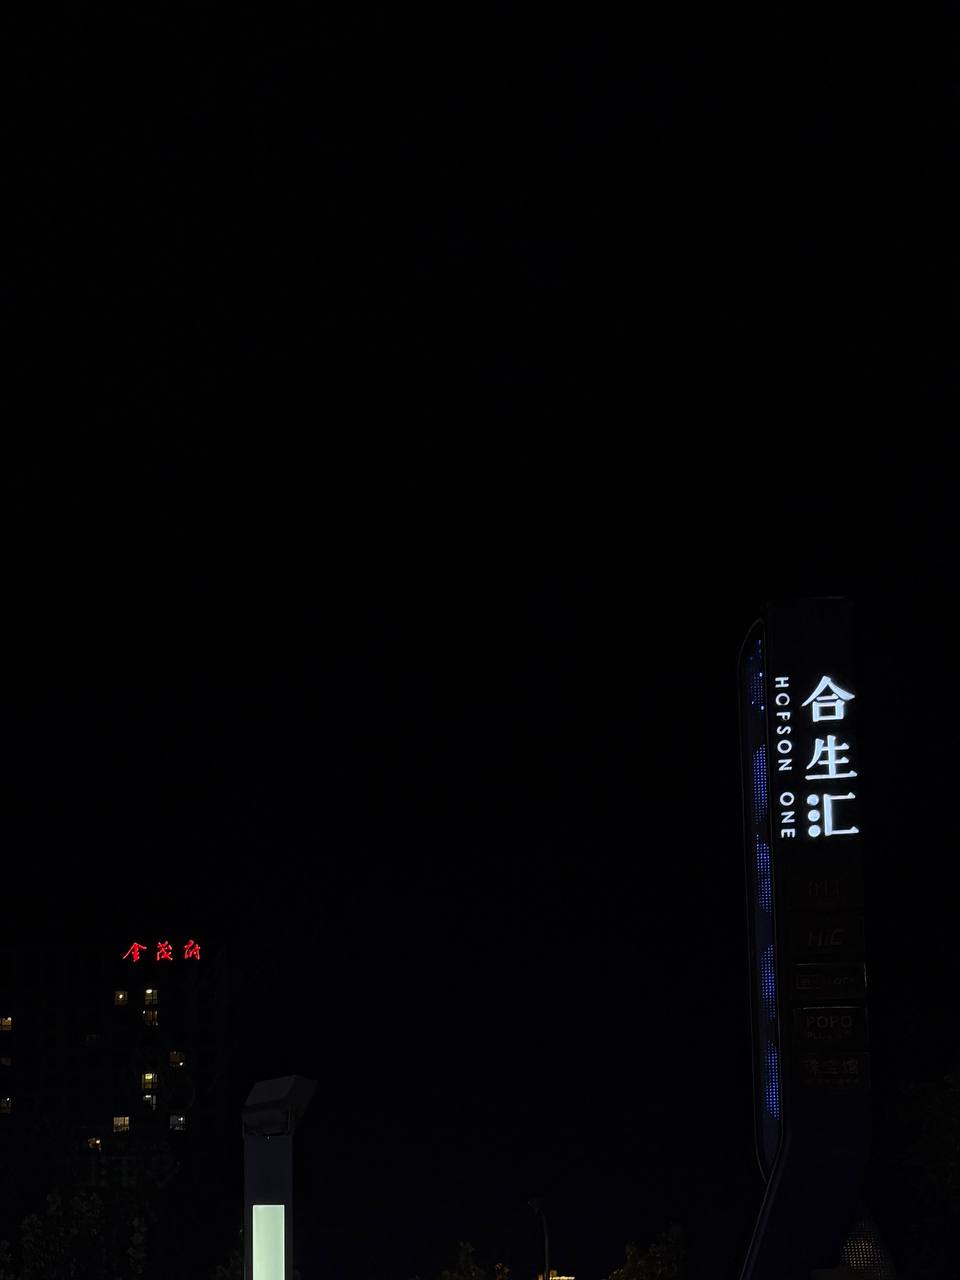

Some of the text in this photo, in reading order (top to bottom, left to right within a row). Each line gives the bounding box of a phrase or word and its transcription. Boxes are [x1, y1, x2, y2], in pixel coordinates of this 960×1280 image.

[801, 675, 859, 838] 合生汇
[779, 791, 795, 838] ONE
